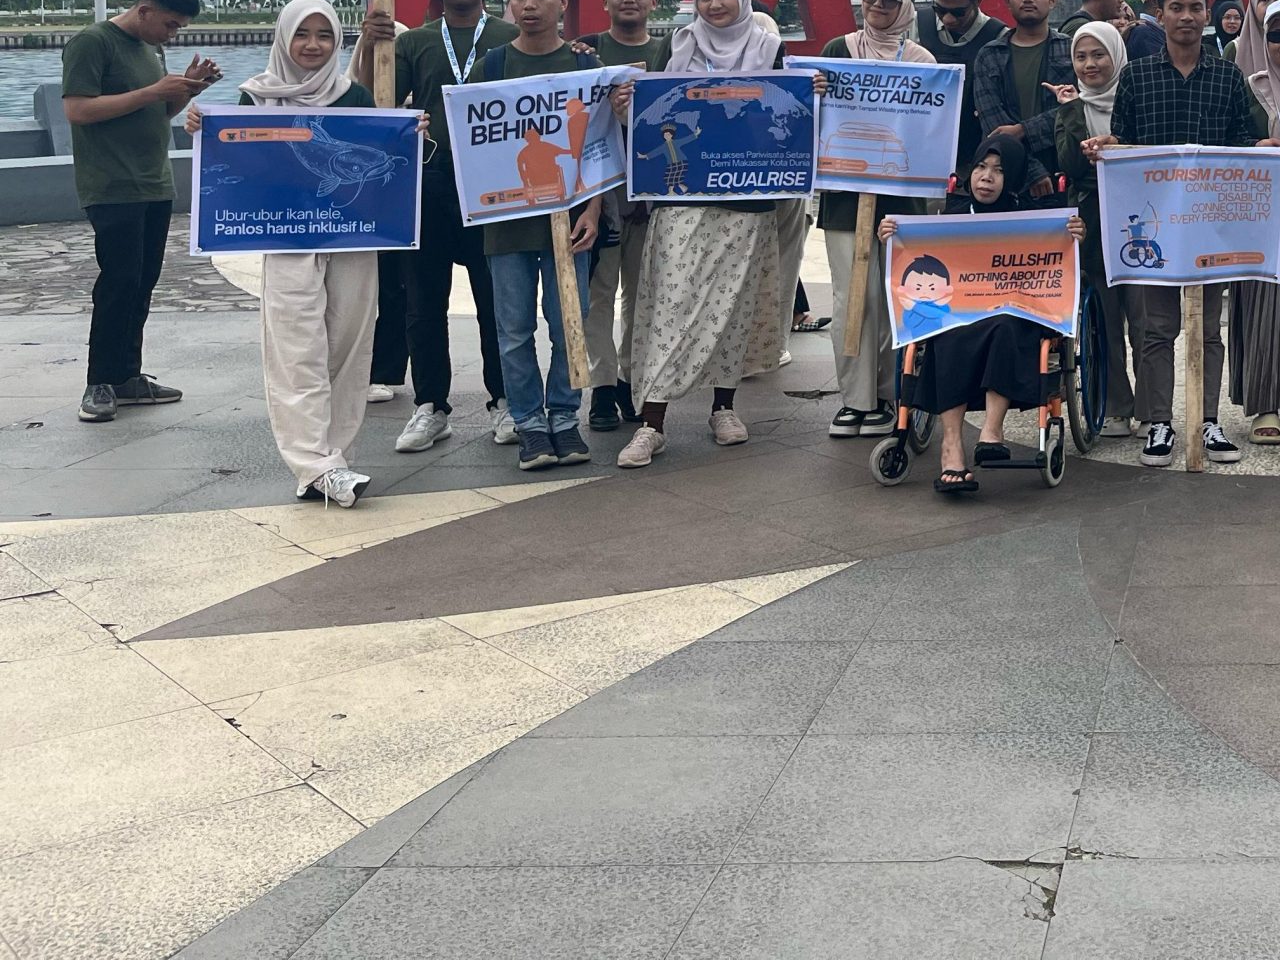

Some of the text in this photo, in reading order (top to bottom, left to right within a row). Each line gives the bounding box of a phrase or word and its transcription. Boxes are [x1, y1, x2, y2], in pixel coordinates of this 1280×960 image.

[827, 71, 922, 89] DISABILITAS
[822, 85, 945, 107] RUS TOTALITAS
[468, 100, 506, 123] NO
[516, 90, 568, 116] ONE
[471, 115, 562, 146] BEHIND
[746, 151, 784, 159] Pariwisata
[711, 160, 731, 168] Demi
[707, 172, 807, 188] EQUALRISE
[1144, 168, 1272, 183] TOURISM FOR ALL
[1185, 183, 1271, 192] CONNECTED FOR
[1218, 193, 1271, 202] DISABILITY
[1192, 202, 1271, 213] CONNECTED TO
[215, 208, 344, 221] Ubur-ubur ikan lele,
[1170, 212, 1270, 224] EVERY PERSONALITY
[215, 221, 375, 235] Panlos harus inklusif le!
[992, 252, 1063, 267] BULLSHIT!
[959, 270, 1063, 282] NOTHING ABOUT US
[994, 280, 1045, 289] WITHOUT
